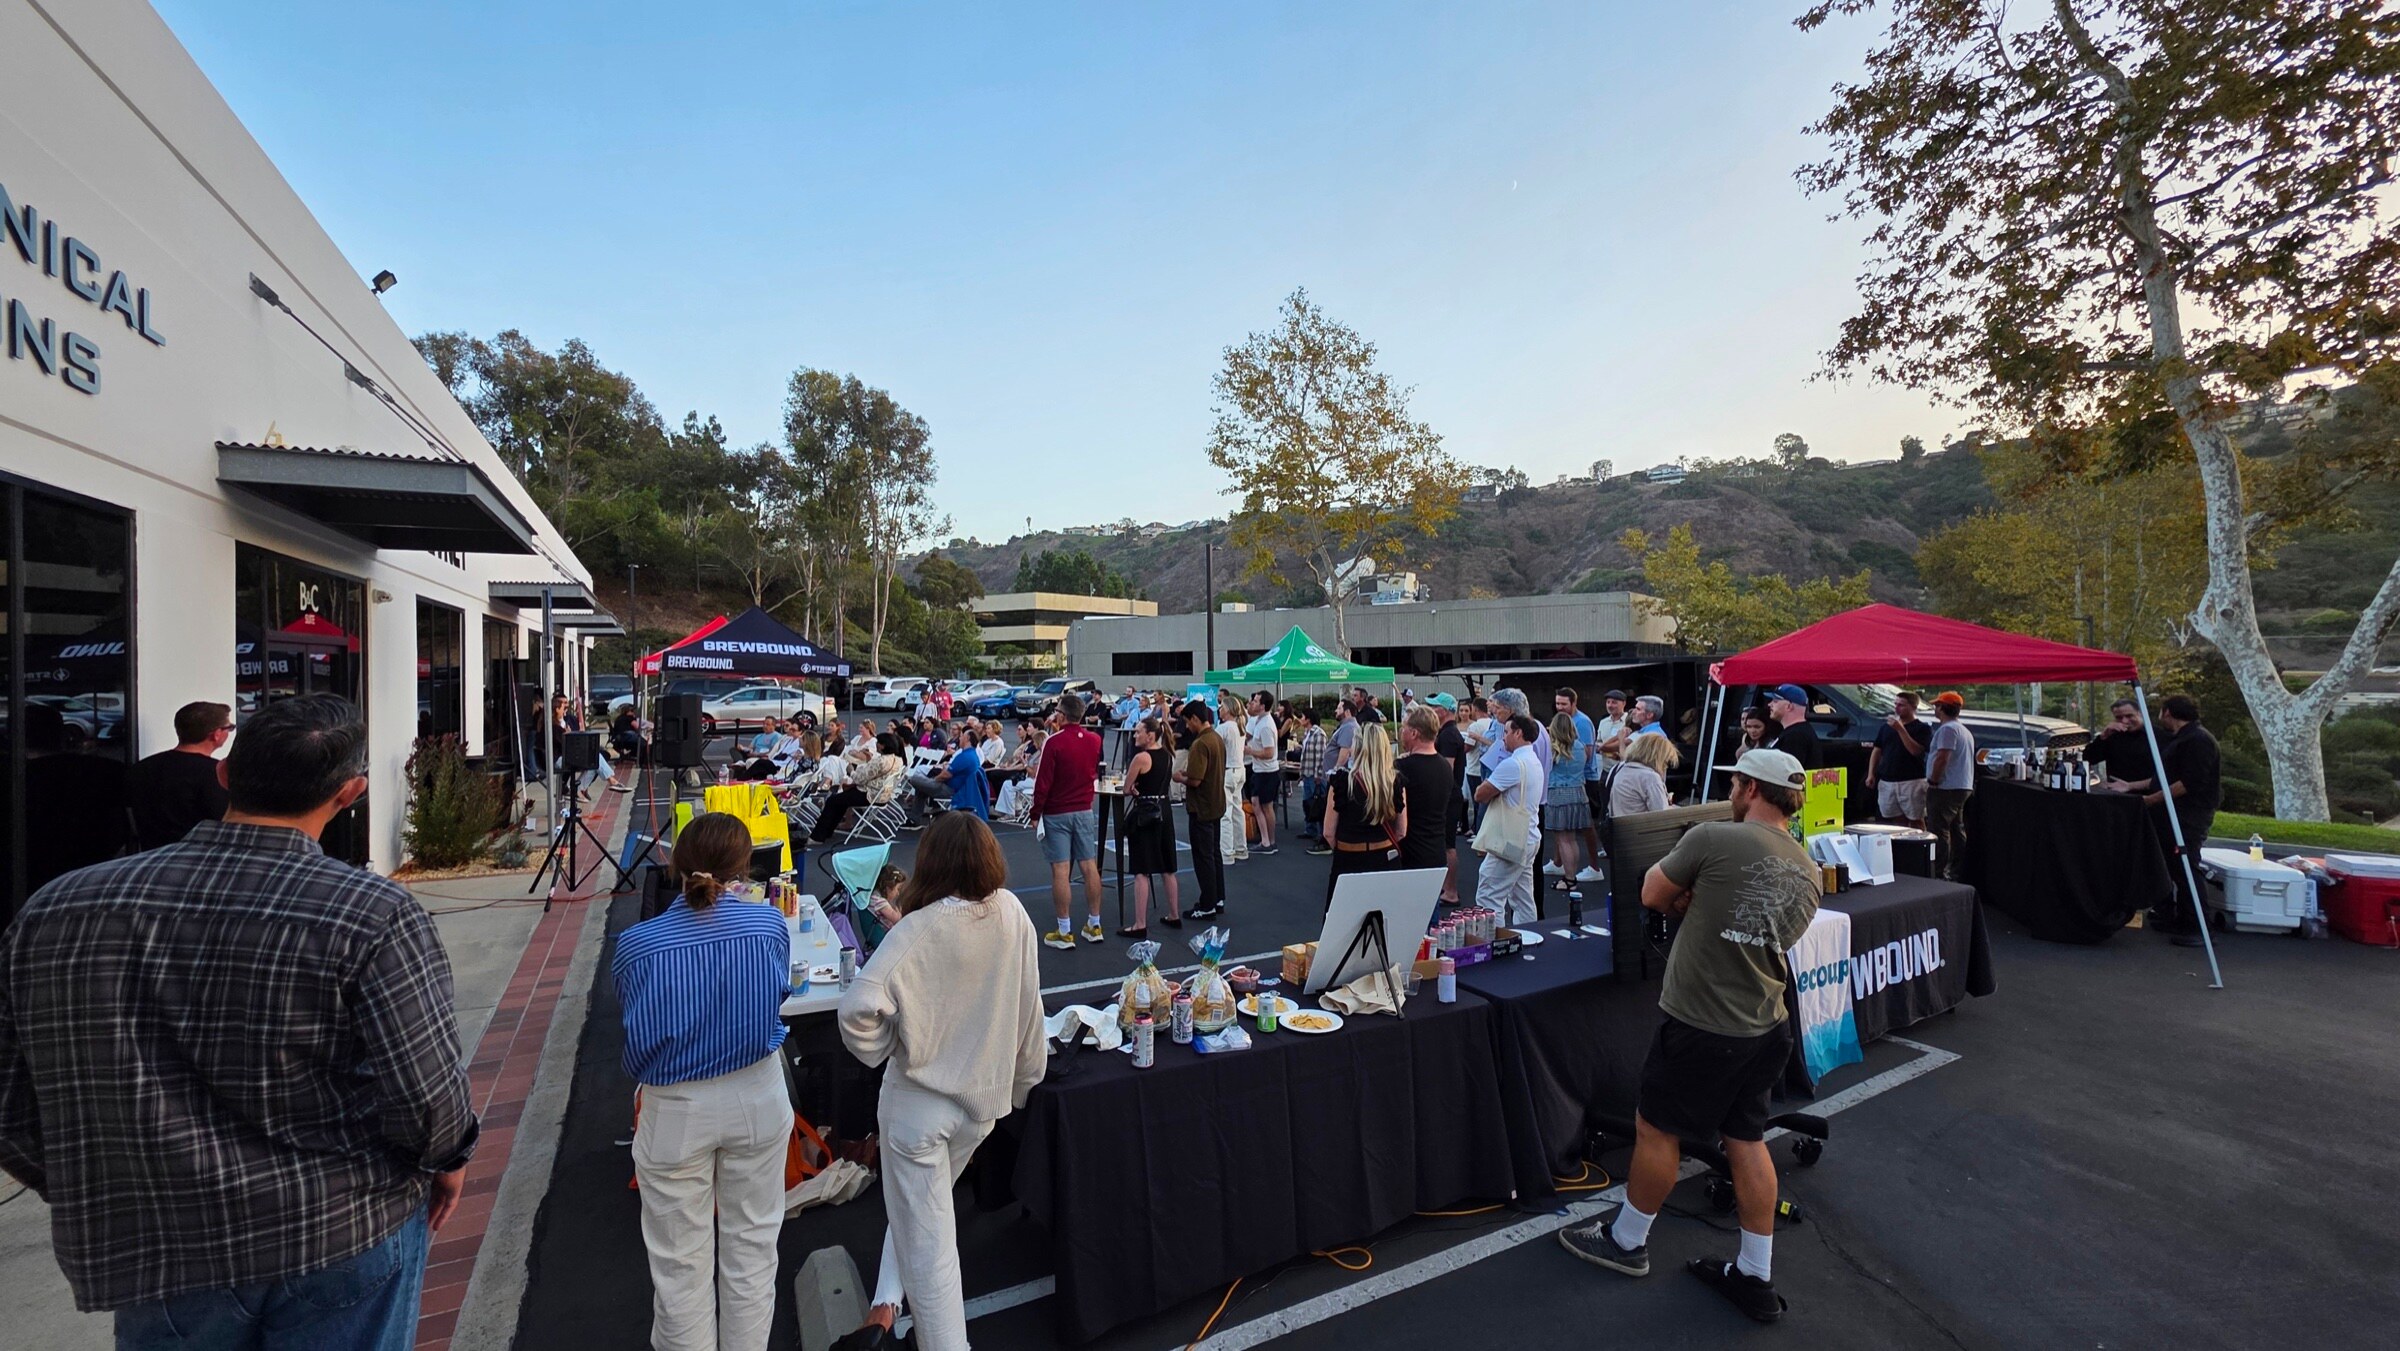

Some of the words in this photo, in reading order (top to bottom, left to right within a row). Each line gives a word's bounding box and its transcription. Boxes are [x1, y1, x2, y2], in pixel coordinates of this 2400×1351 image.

[0, 183, 166, 347] NICAL
[0, 296, 101, 395] NS
[1797, 959, 1849, 993] ecoup
